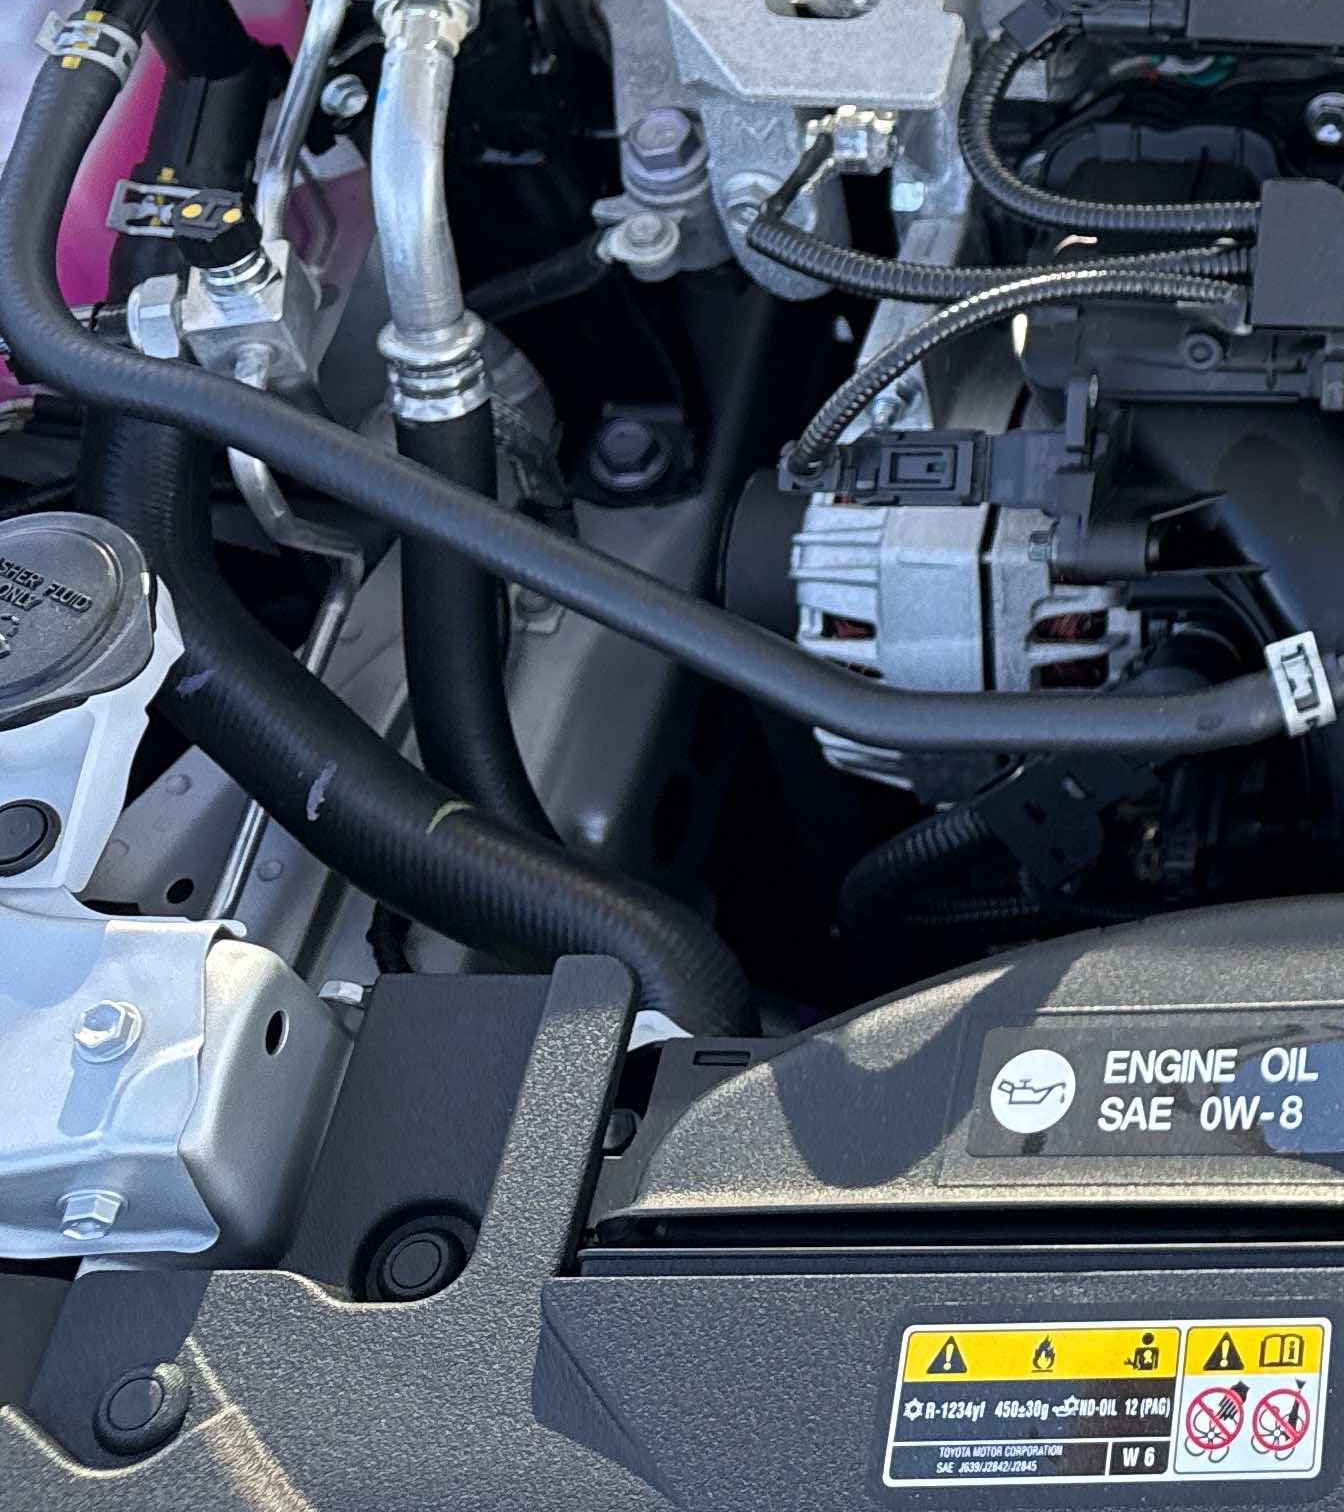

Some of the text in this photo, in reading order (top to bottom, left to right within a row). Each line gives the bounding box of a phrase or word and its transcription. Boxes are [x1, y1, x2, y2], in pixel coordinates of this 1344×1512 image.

[0, 558, 93, 614] SHER FLUID
[0, 582, 42, 612] ONLY
[1103, 1046, 1320, 1085] ENGINE OIL
[1096, 1094, 1304, 1132] SAE 0W-8
[924, 1397, 1171, 1422] R-1234yf 450±30g ND-OIL 12 (PAG)
[938, 1444, 1064, 1459] TOYOTA MOTOR CORPORATION
[1121, 1446, 1156, 1468] W 6
[935, 1459, 1038, 1474] SAE J639/J2842/J2845
